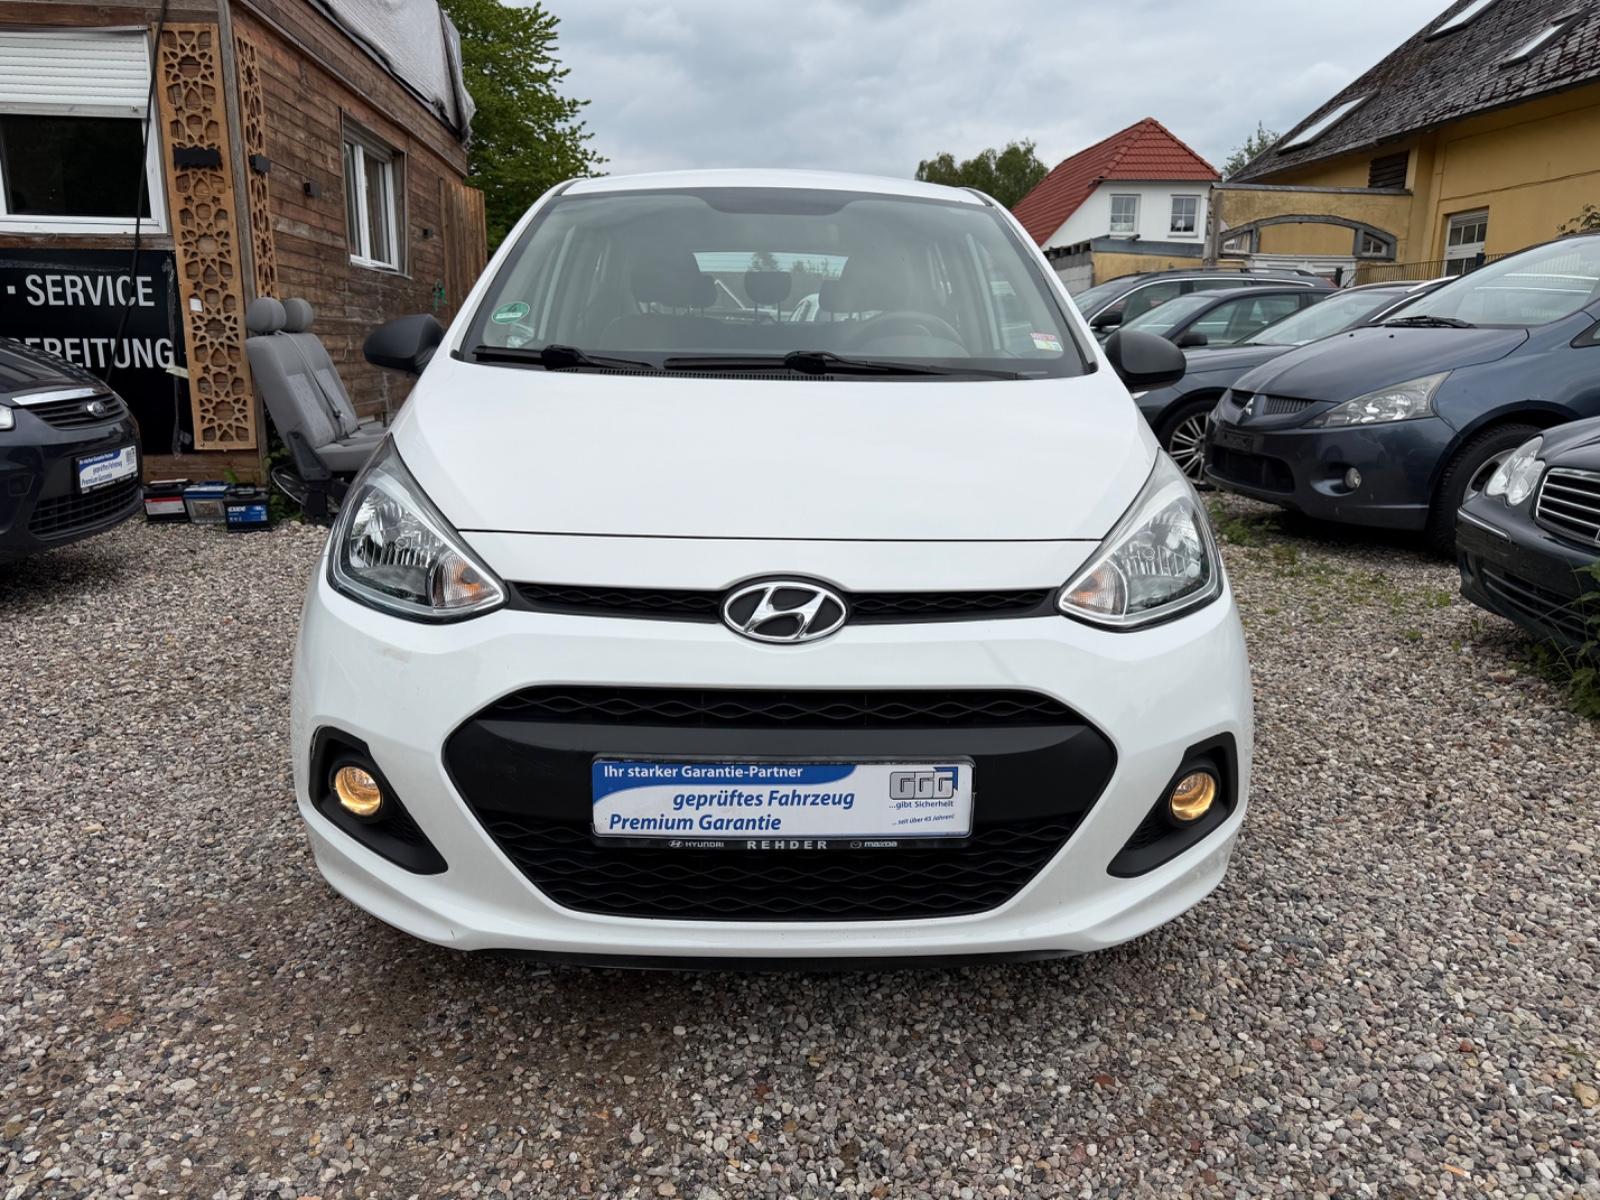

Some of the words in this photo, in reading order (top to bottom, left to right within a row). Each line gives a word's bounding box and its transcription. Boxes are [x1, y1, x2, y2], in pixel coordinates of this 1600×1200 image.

[25, 274, 155, 306] SERVICE
[604, 766, 623, 777] Ihr
[628, 766, 678, 778] starker
[682, 766, 803, 778] Garantie-Partner
[673, 790, 763, 810] geprüftes
[768, 790, 855, 810] Fahrzeug
[914, 800, 954, 808] Sicherheit
[609, 814, 693, 830] Premium
[699, 814, 782, 831] Garantie
[747, 841, 827, 849] REHDER
